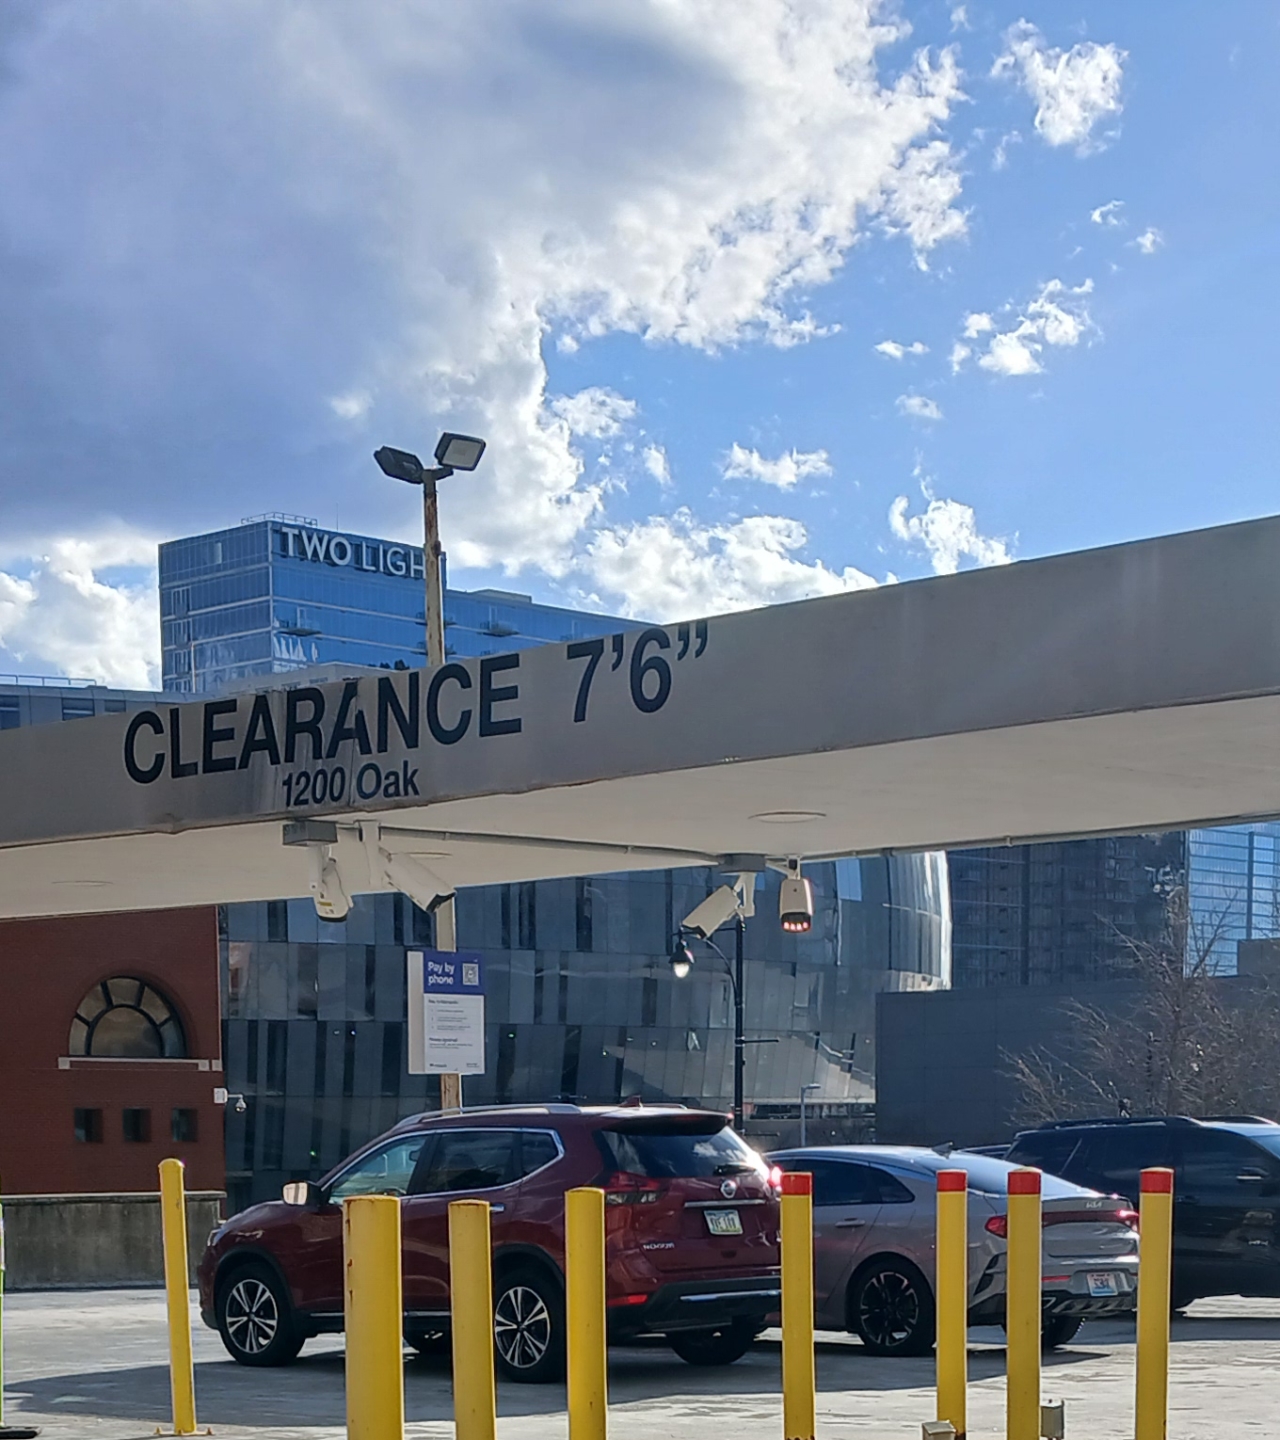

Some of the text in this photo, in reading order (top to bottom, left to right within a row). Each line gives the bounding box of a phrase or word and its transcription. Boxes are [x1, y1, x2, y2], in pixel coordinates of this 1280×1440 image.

[281, 526, 427, 580] TWO LIGH
[124, 653, 522, 784] CLEARANCE
[282, 760, 420, 807] 1200 Oak
[428, 961, 455, 975] Pay by
[428, 975, 454, 986] phone
